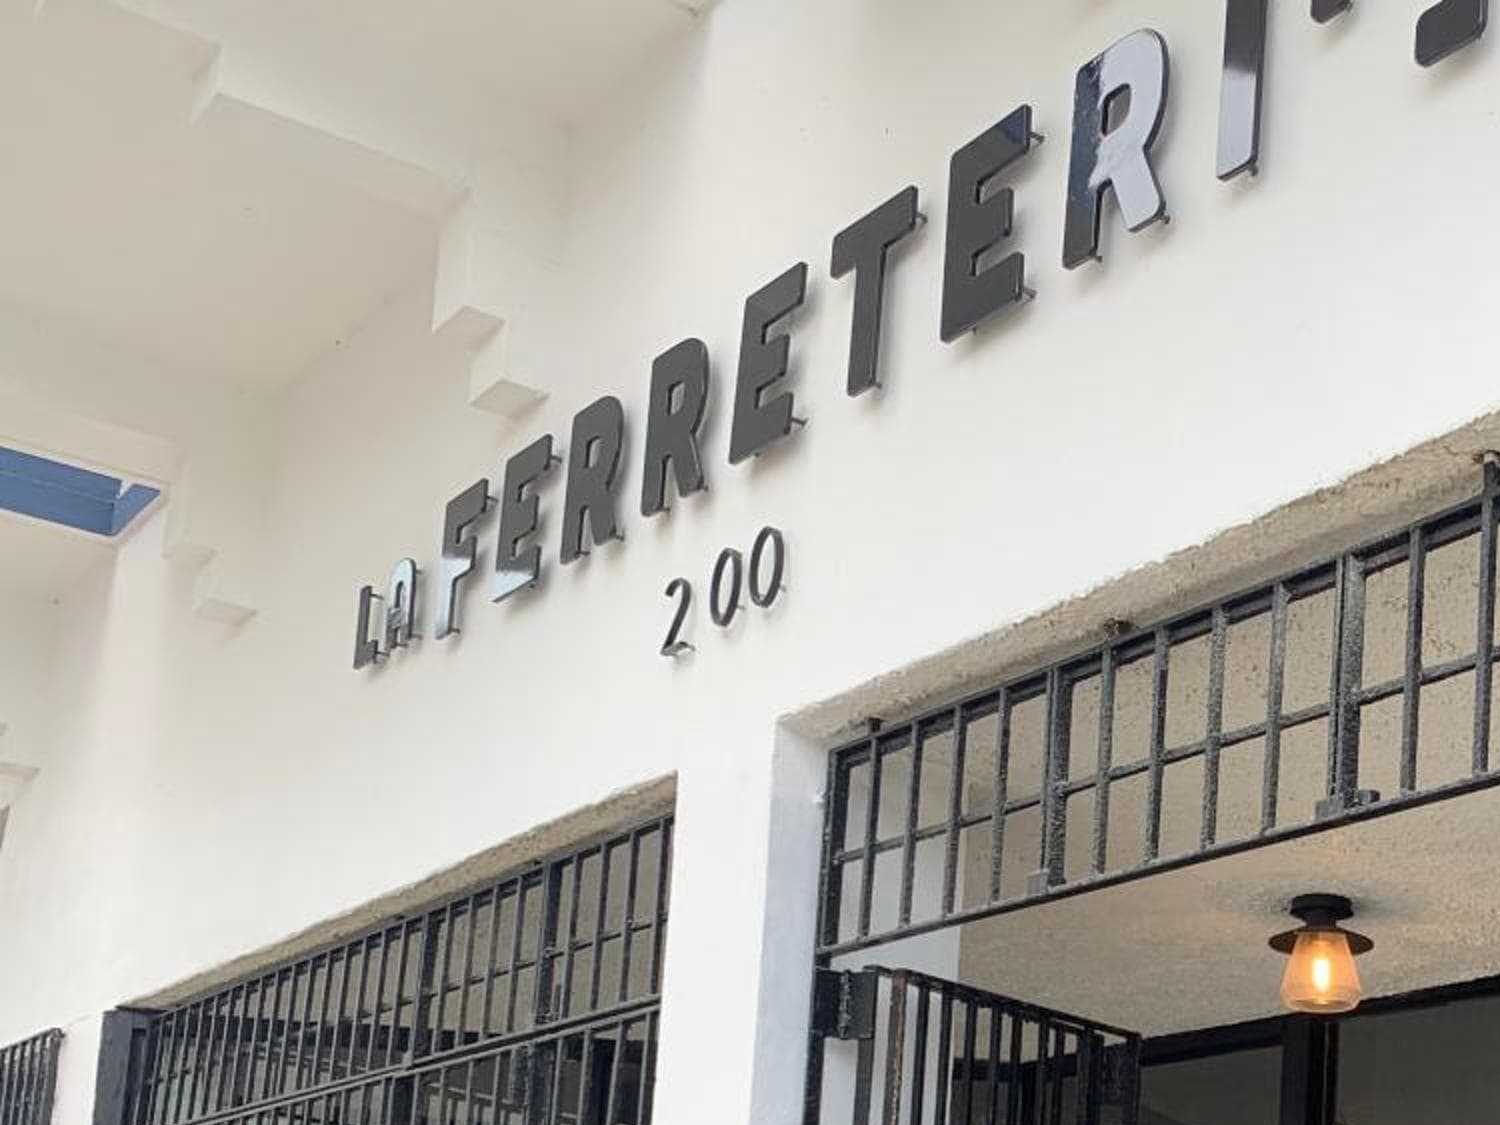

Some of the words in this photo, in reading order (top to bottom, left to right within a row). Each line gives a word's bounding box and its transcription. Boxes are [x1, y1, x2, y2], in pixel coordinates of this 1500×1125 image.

[353, 557, 417, 670] LA
[433, 0, 1488, 641] FERRETERI
[661, 526, 784, 656] 200
